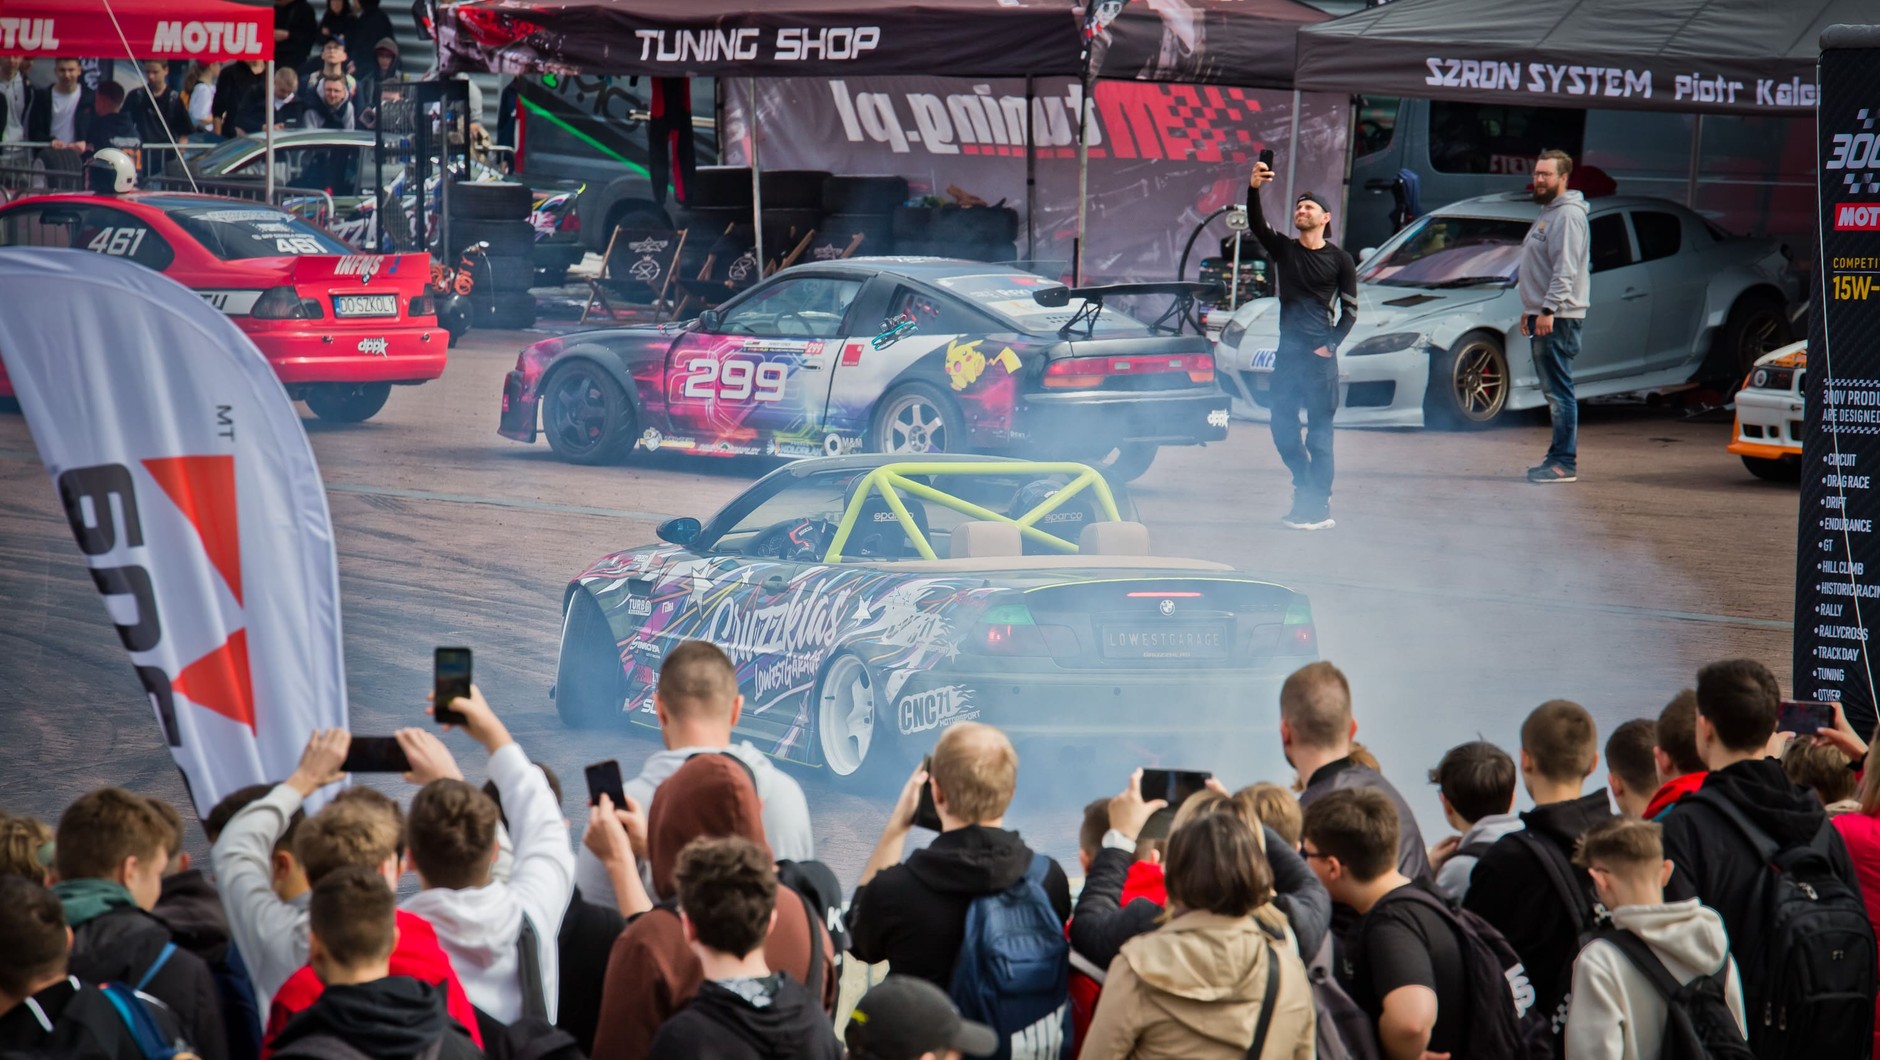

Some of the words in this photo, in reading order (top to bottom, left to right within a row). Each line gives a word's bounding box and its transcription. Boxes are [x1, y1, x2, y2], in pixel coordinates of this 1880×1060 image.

[0, 18, 60, 50] TUL
[152, 21, 263, 54] MOTUL
[635, 28, 760, 61] TUNING
[774, 26, 881, 60] SHOP
[1425, 57, 1521, 90] SZRON
[1527, 63, 1653, 98] SYSTEM
[1675, 72, 1744, 104] Piotr
[88, 227, 147, 256] 461
[276, 238, 328, 254] 461
[340, 298, 355, 312] DO
[684, 358, 788, 402] 299
[1822, 408, 1837, 421] ARE
[217, 404, 234, 442] MT
[1827, 453, 1857, 467] CIRCUIT
[1826, 474, 1847, 488] DRAG
[1848, 476, 1870, 489] RACE
[1825, 496, 1847, 509] DRIFT
[1044, 511, 1083, 523] sparco
[1824, 517, 1872, 532] ENDURANCE
[1823, 539, 1834, 552] GT
[1822, 560, 1838, 574] HILL
[1838, 562, 1864, 576] CLIMB
[1821, 582, 1855, 597] HISTORIC
[1820, 603, 1844, 617] RALLY
[1818, 625, 1869, 641] RALLYCROSS
[1817, 667, 1845, 682] TUNING
[1817, 688, 1841, 701] OTHER
[900, 688, 951, 732] CNC71
